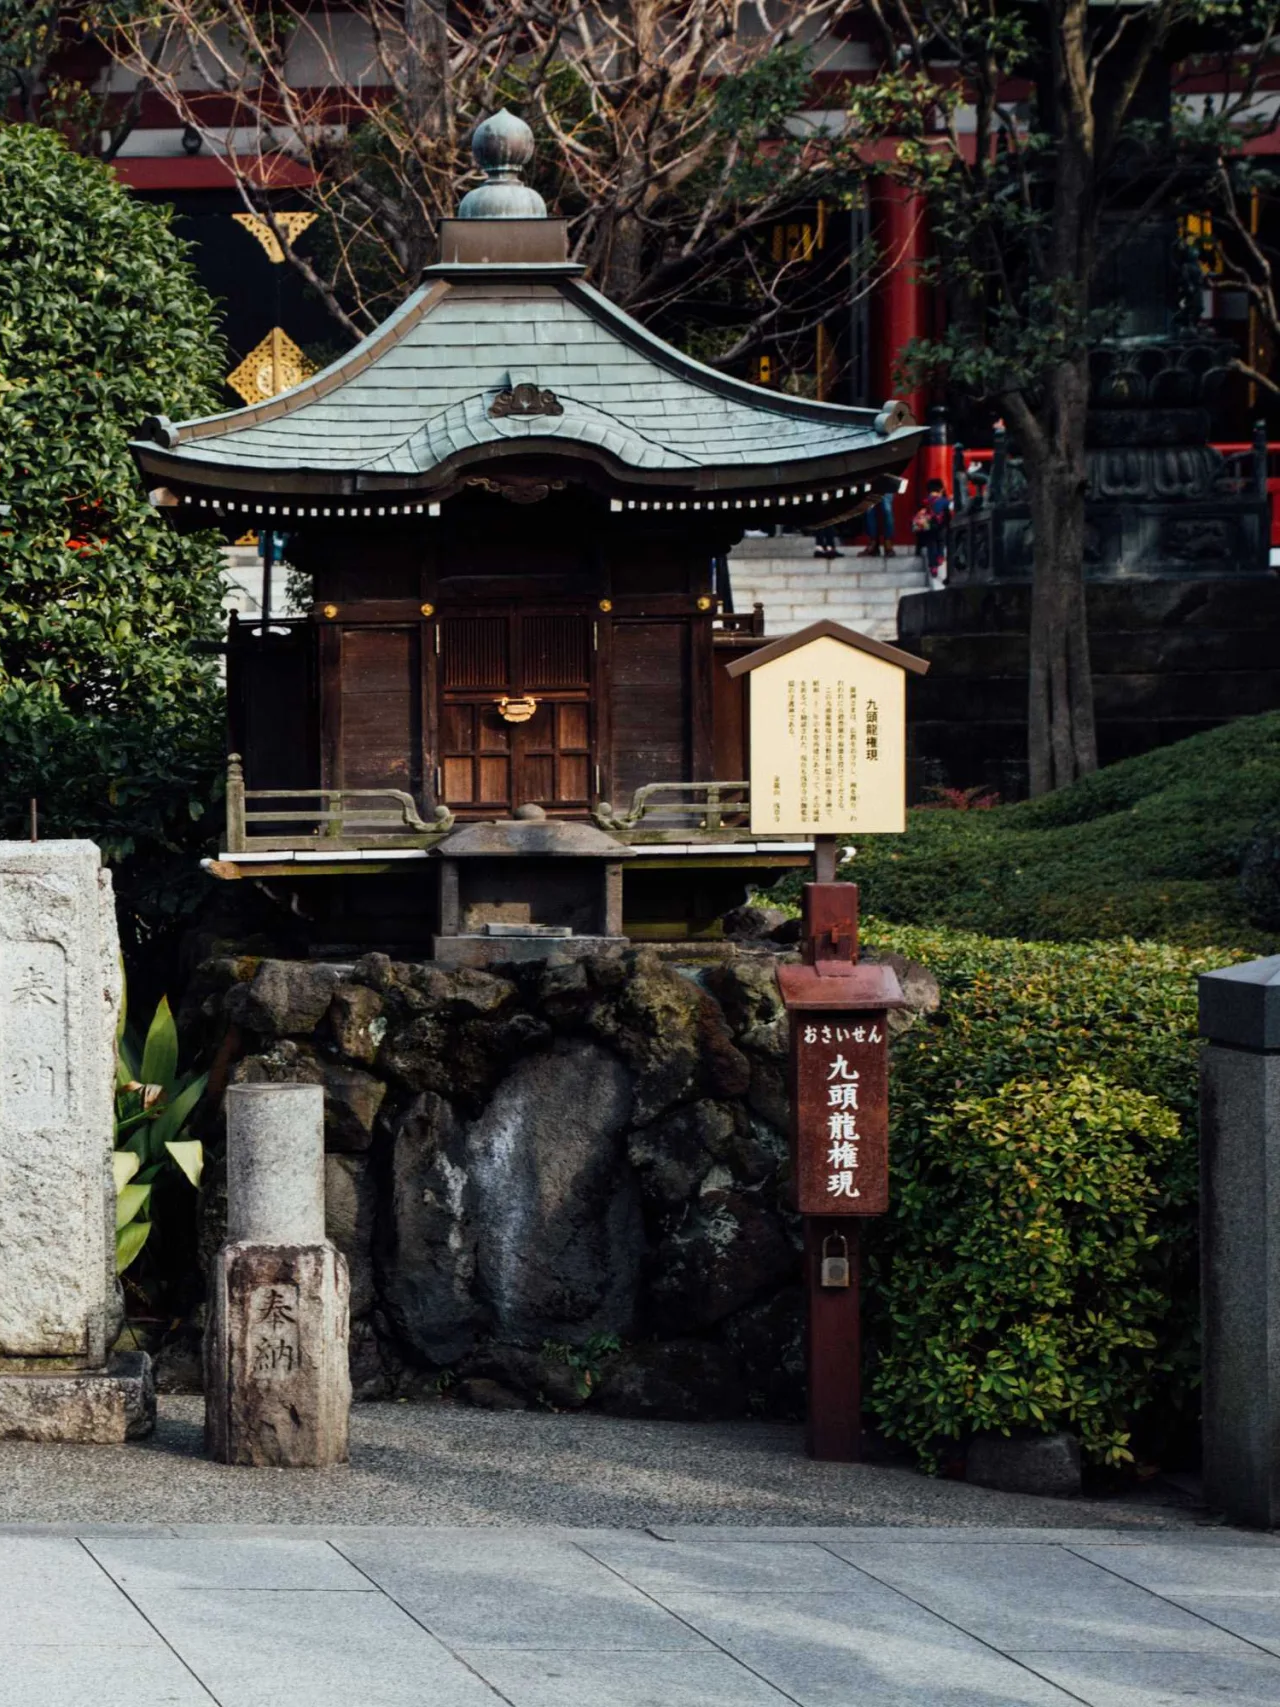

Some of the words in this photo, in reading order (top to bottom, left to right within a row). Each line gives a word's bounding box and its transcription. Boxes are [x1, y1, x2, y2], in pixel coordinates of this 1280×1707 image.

[865, 698, 878, 762] 九頭龍権現
[803, 1024, 883, 1044] おさいせん
[826, 1054, 861, 1198] 九頭龍権現
[252, 1288, 297, 1371] 奉納
